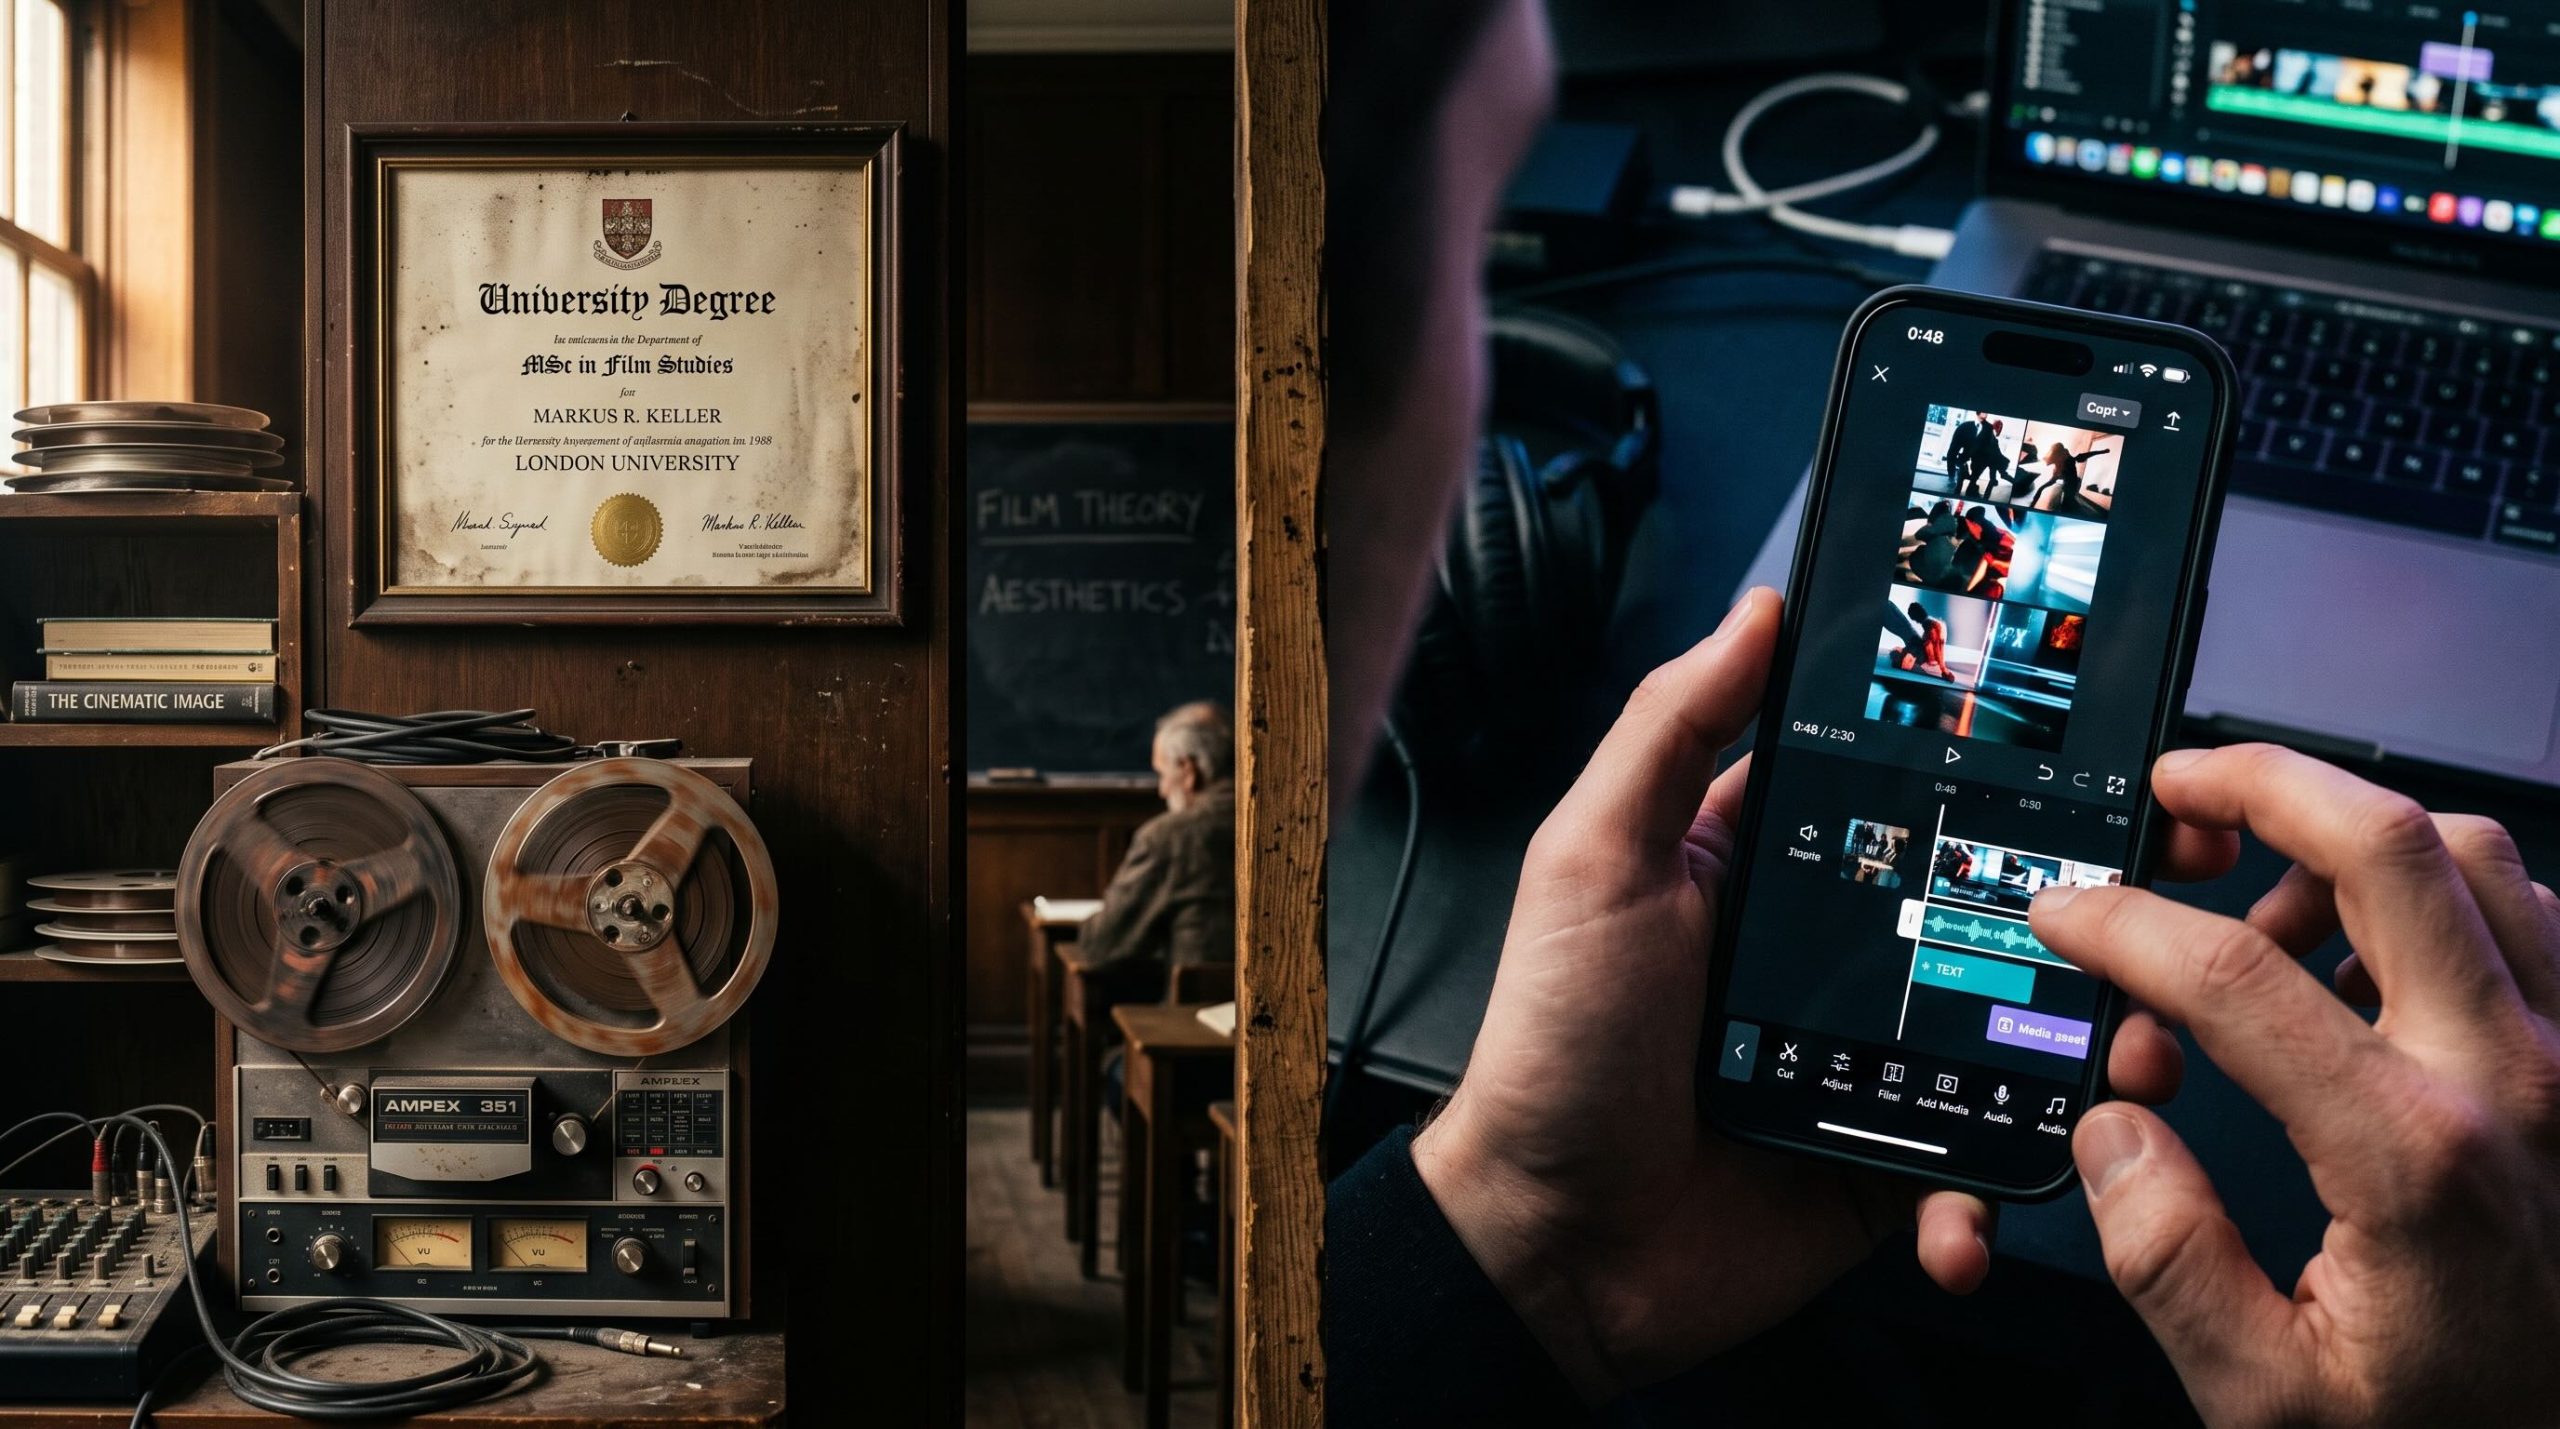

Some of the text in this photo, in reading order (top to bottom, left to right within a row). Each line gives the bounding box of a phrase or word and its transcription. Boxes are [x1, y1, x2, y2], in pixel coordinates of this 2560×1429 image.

[479, 283, 775, 320] University Degree
[622, 335, 634, 343] the
[638, 335, 689, 346] Department
[692, 335, 703, 346] of
[1908, 327, 1943, 344] 0:48
[521, 355, 733, 376] MSc in Film Studies
[535, 409, 721, 423] MARKUS R. KELLER
[481, 436, 496, 447] for
[499, 436, 512, 445] the
[623, 436, 633, 447] of
[750, 436, 772, 445] 1988
[516, 455, 739, 471] LONDON UNIVERSITY
[976, 488, 1205, 534] FILM THEORY
[978, 572, 1187, 617] AESTHETICS
[48, 694, 78, 708] THE
[84, 694, 167, 709] CINEMATIC
[175, 694, 224, 708] IMAGE
[1793, 722, 1818, 734] 0:48
[1830, 729, 1854, 742] 2:30
[1935, 783, 1956, 794] 0:48
[2107, 815, 2128, 825] 0:30
[1937, 964, 1964, 977] TEXT
[2019, 1024, 2051, 1038] Media
[1777, 1068, 1794, 1079] Cut
[1822, 1078, 1852, 1091] Adjust
[385, 1100, 515, 1112] AMPEX 351
[1917, 1097, 1968, 1115] Add Media
[1984, 1111, 2012, 1124] Audio
[2038, 1123, 2066, 1135] Audio
[417, 1247, 431, 1255] VU
[531, 1248, 546, 1256] VU
